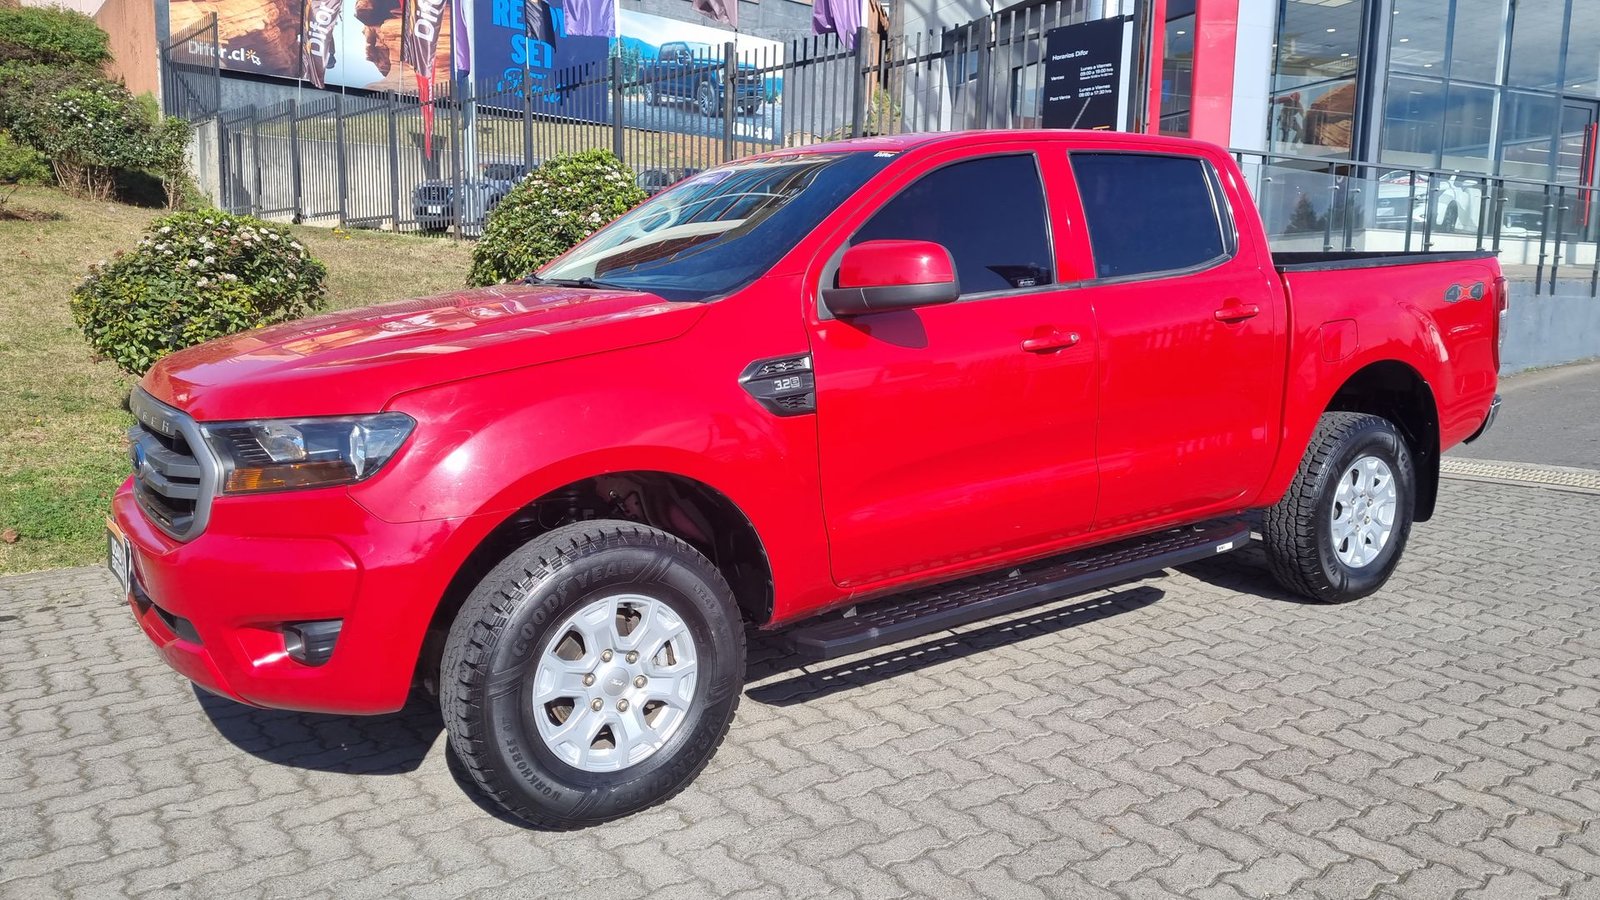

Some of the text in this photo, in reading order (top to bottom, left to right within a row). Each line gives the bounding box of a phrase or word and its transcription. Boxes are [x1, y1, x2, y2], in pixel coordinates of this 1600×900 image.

[511, 33, 553, 69] SET
[1052, 53, 1075, 61] Horarios
[513, 558, 637, 658] GOODYEAR
[507, 738, 564, 801] WORKHORSE
